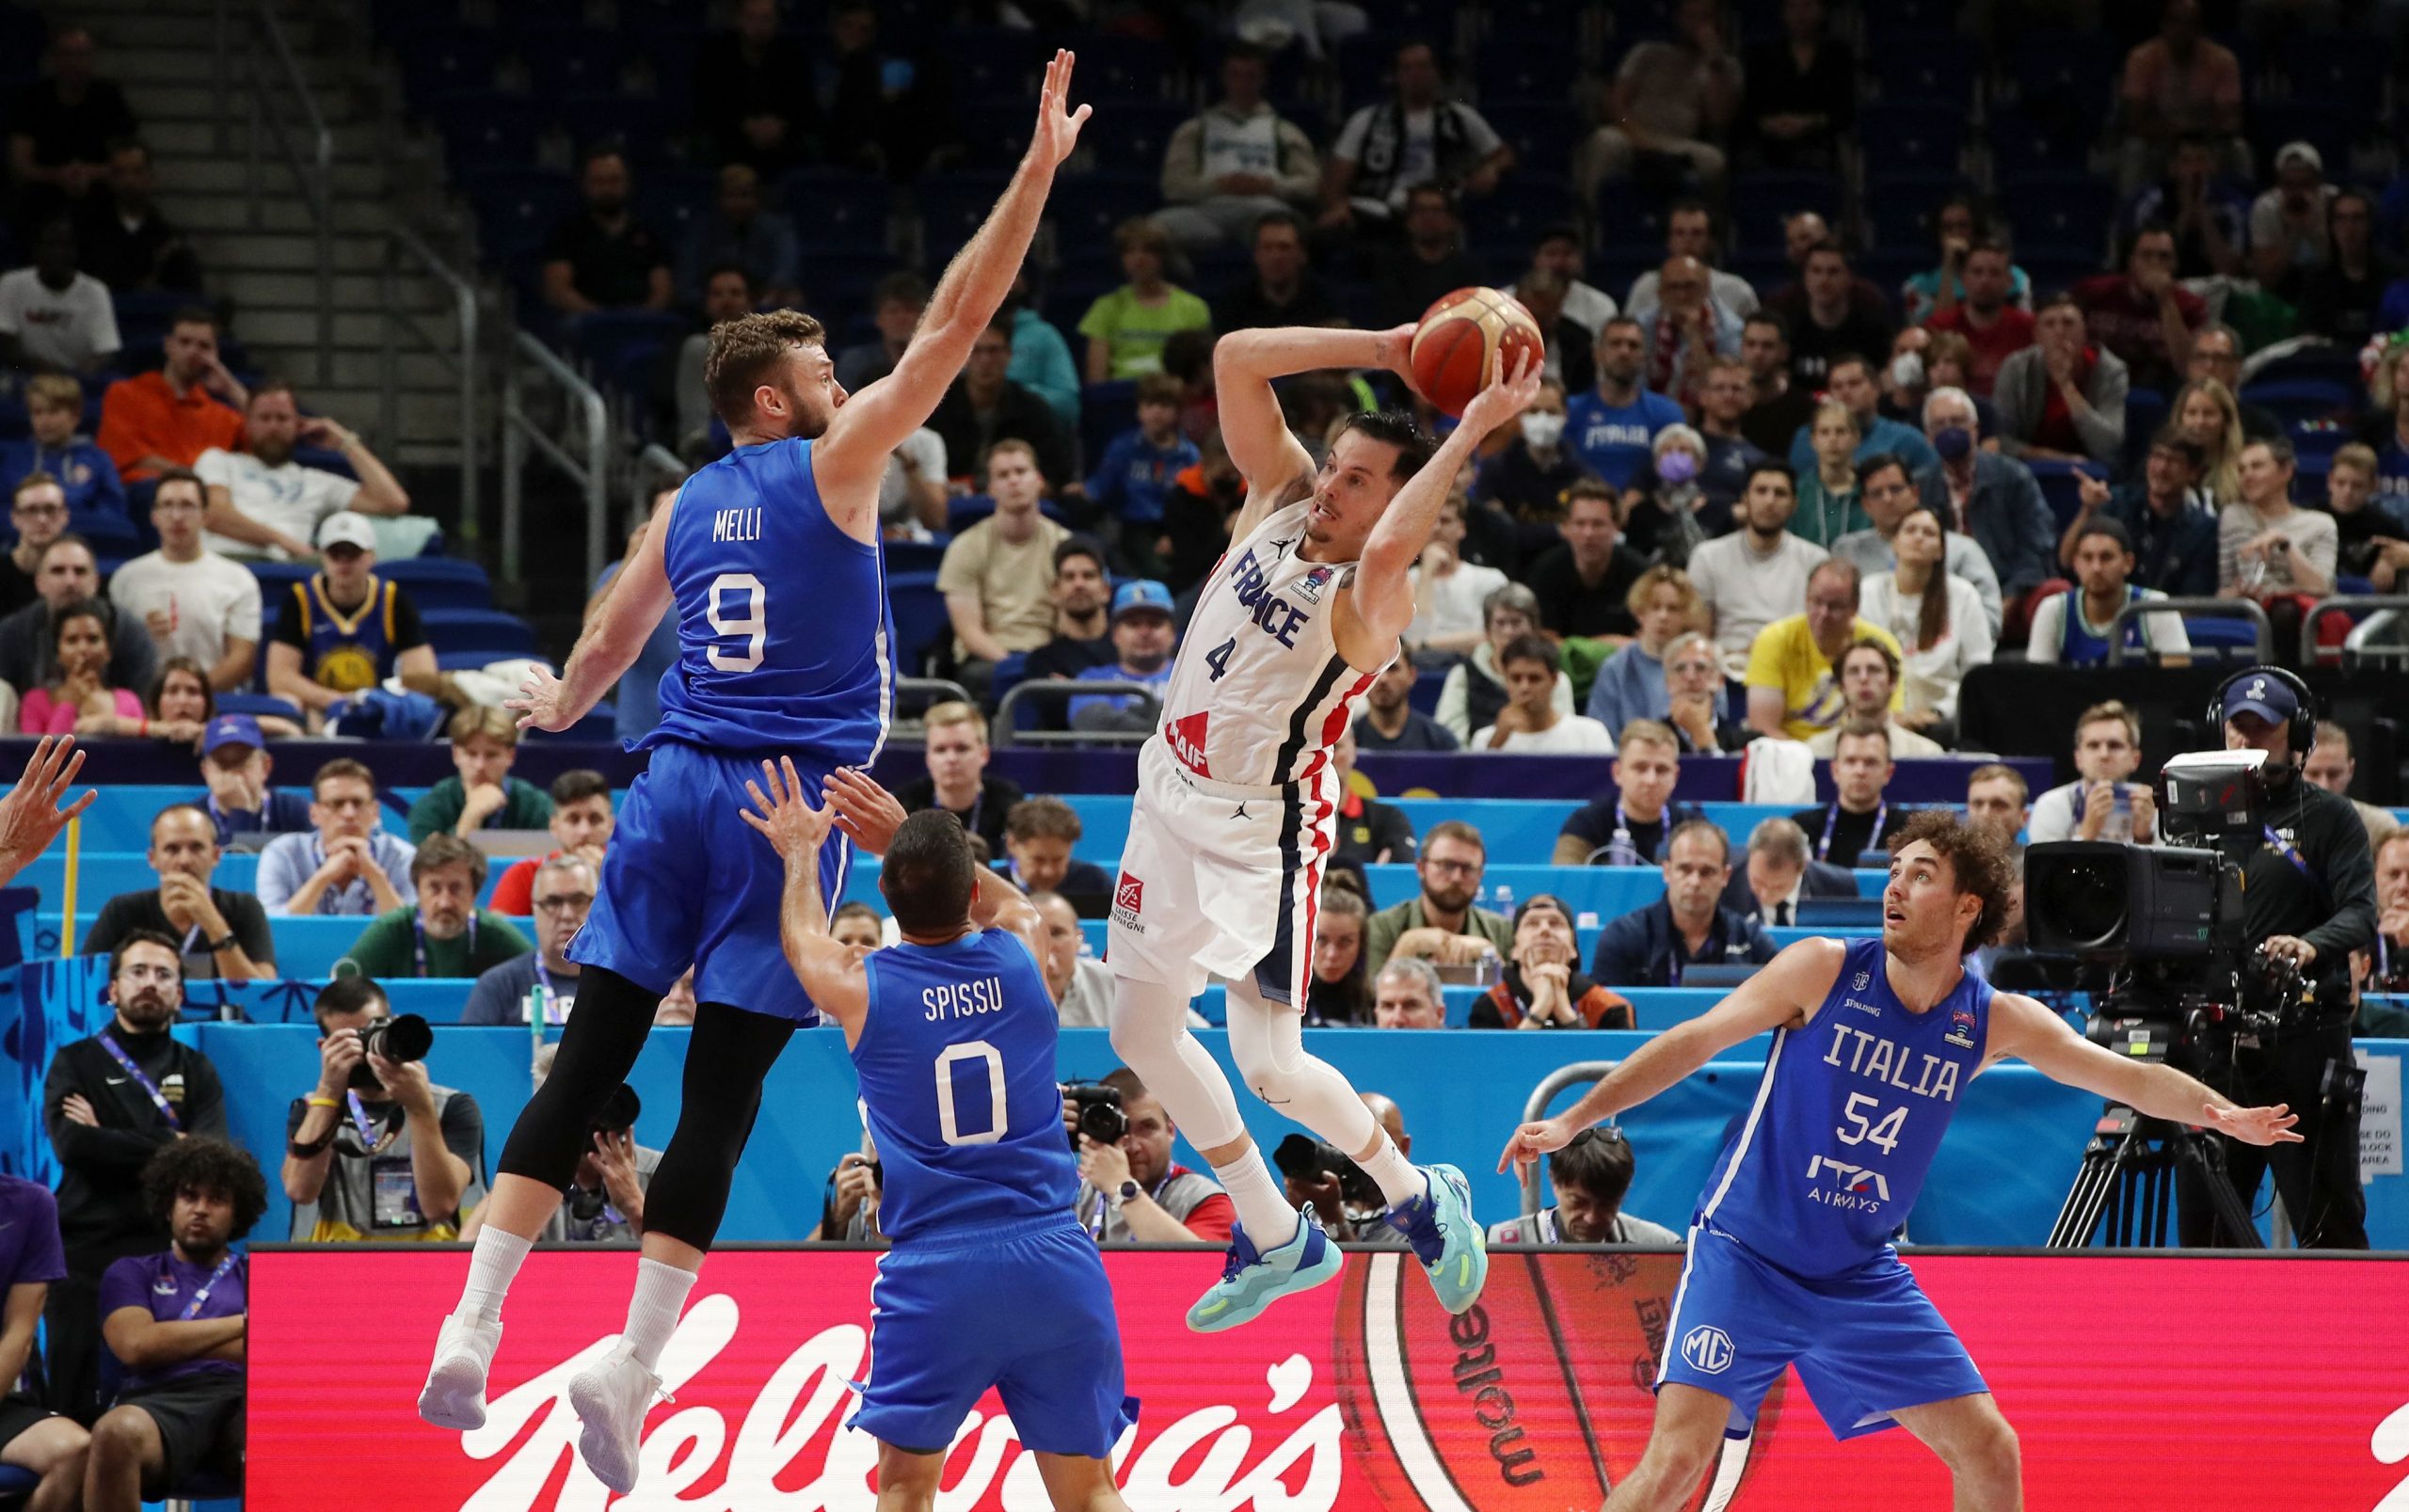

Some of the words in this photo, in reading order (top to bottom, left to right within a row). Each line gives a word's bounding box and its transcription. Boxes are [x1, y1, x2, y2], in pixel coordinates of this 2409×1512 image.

[712, 506, 762, 543] MELLI
[1230, 547, 1311, 651] FRANCE
[707, 573, 767, 674] 9
[1205, 636, 1236, 683] 4
[922, 977, 1003, 1022] SPISSU
[1843, 997, 1882, 1018] SPALDING
[1823, 1023, 1960, 1103] ITALIA
[934, 1040, 1009, 1147] 0
[1836, 1090, 1909, 1156] 54
[1806, 1154, 1891, 1202] ITA
[1808, 1187, 1880, 1214] AIRWAYS
[1683, 1328, 1732, 1372] MG
[1449, 1295, 1545, 1488] molte
